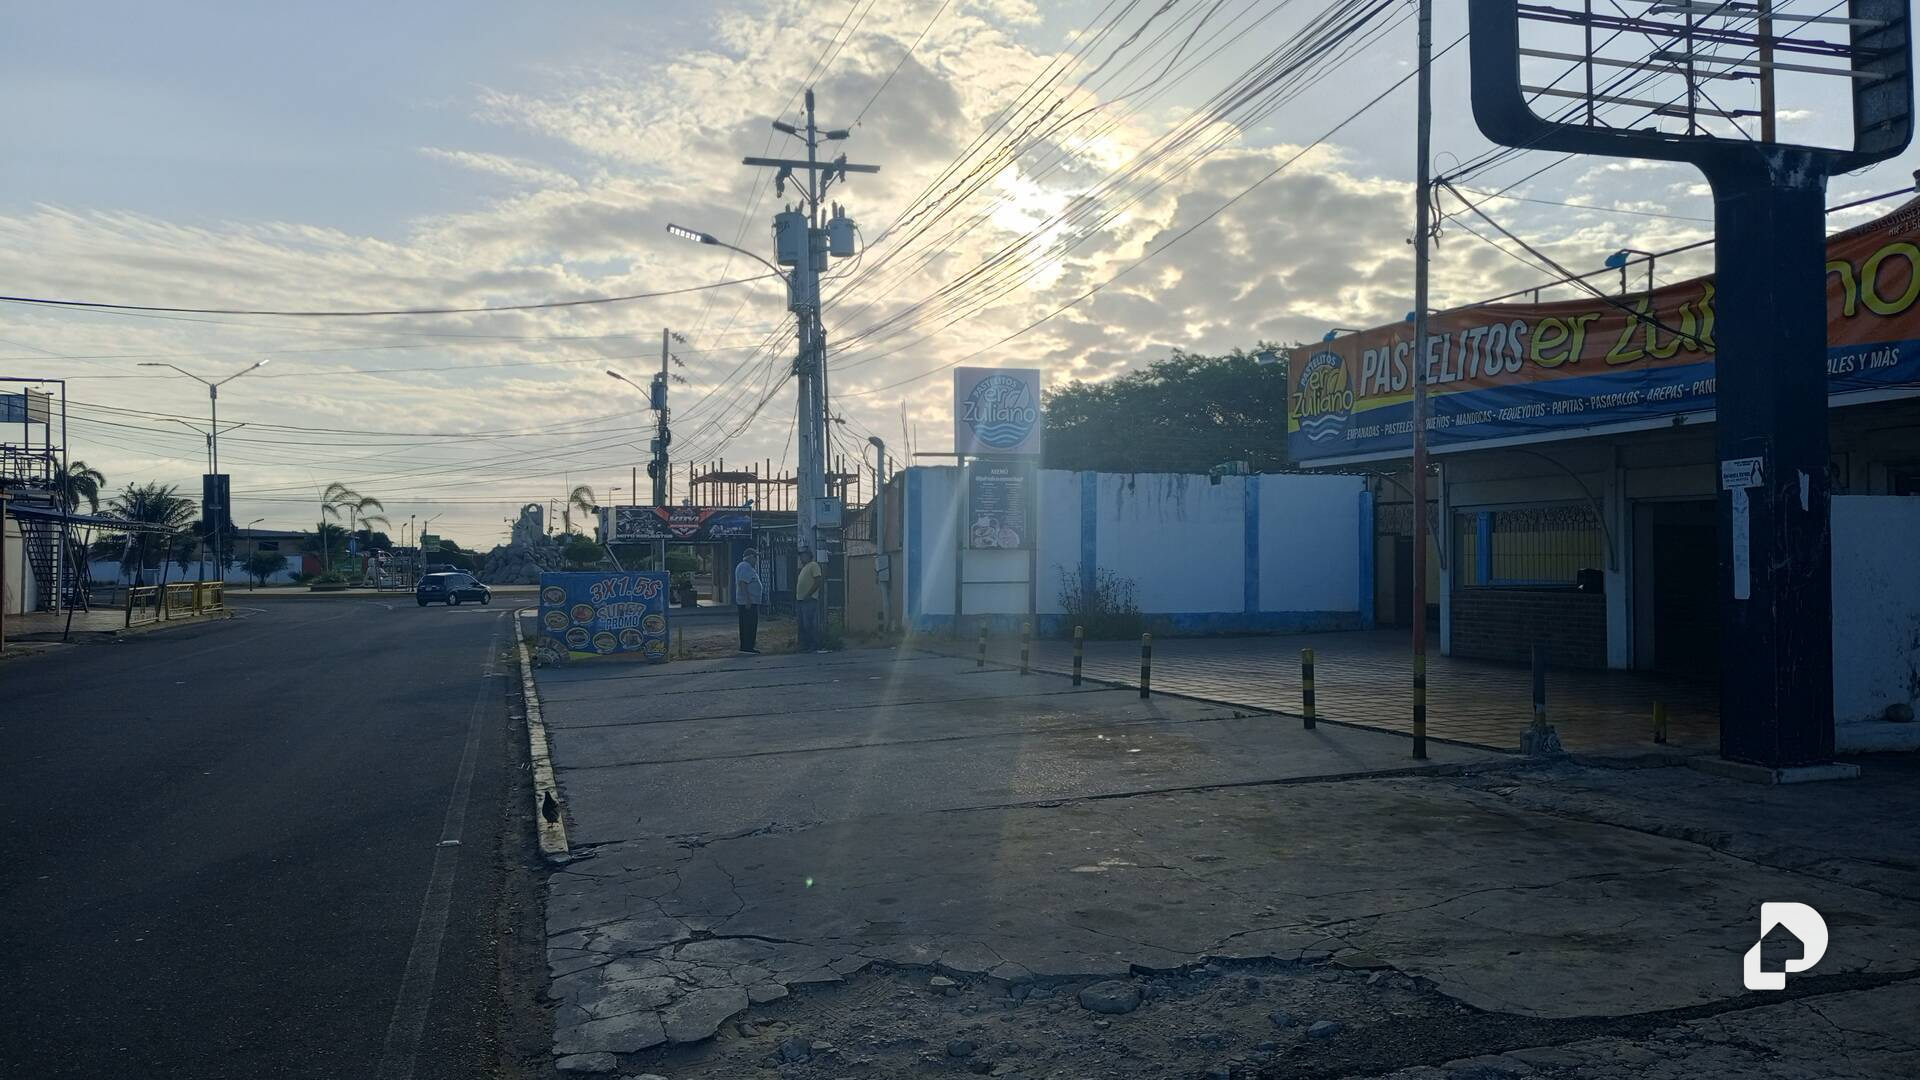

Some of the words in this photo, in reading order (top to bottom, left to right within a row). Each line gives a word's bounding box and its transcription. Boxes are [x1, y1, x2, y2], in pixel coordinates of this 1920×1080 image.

[1300, 354, 1336, 386] PASTELITOS
[1359, 319, 1528, 398] PASELITOS
[1531, 315, 1602, 368] er
[1859, 353, 1867, 370] Y
[962, 401, 1036, 423] Zuliano
[1292, 388, 1354, 418] Zuliano
[1346, 426, 1381, 441] EMPANADAS
[1384, 420, 1414, 435] PASTELES
[1425, 414, 1450, 431] QUEÑOS
[1455, 410, 1492, 426] MANDOCAS
[1499, 403, 1546, 421] TEQUEYOYOS
[1552, 398, 1584, 415] PAPITAS
[1591, 390, 1640, 410] PASAPALOS
[1647, 383, 1684, 402] AREPAS
[605, 616, 640, 630] PROMO
